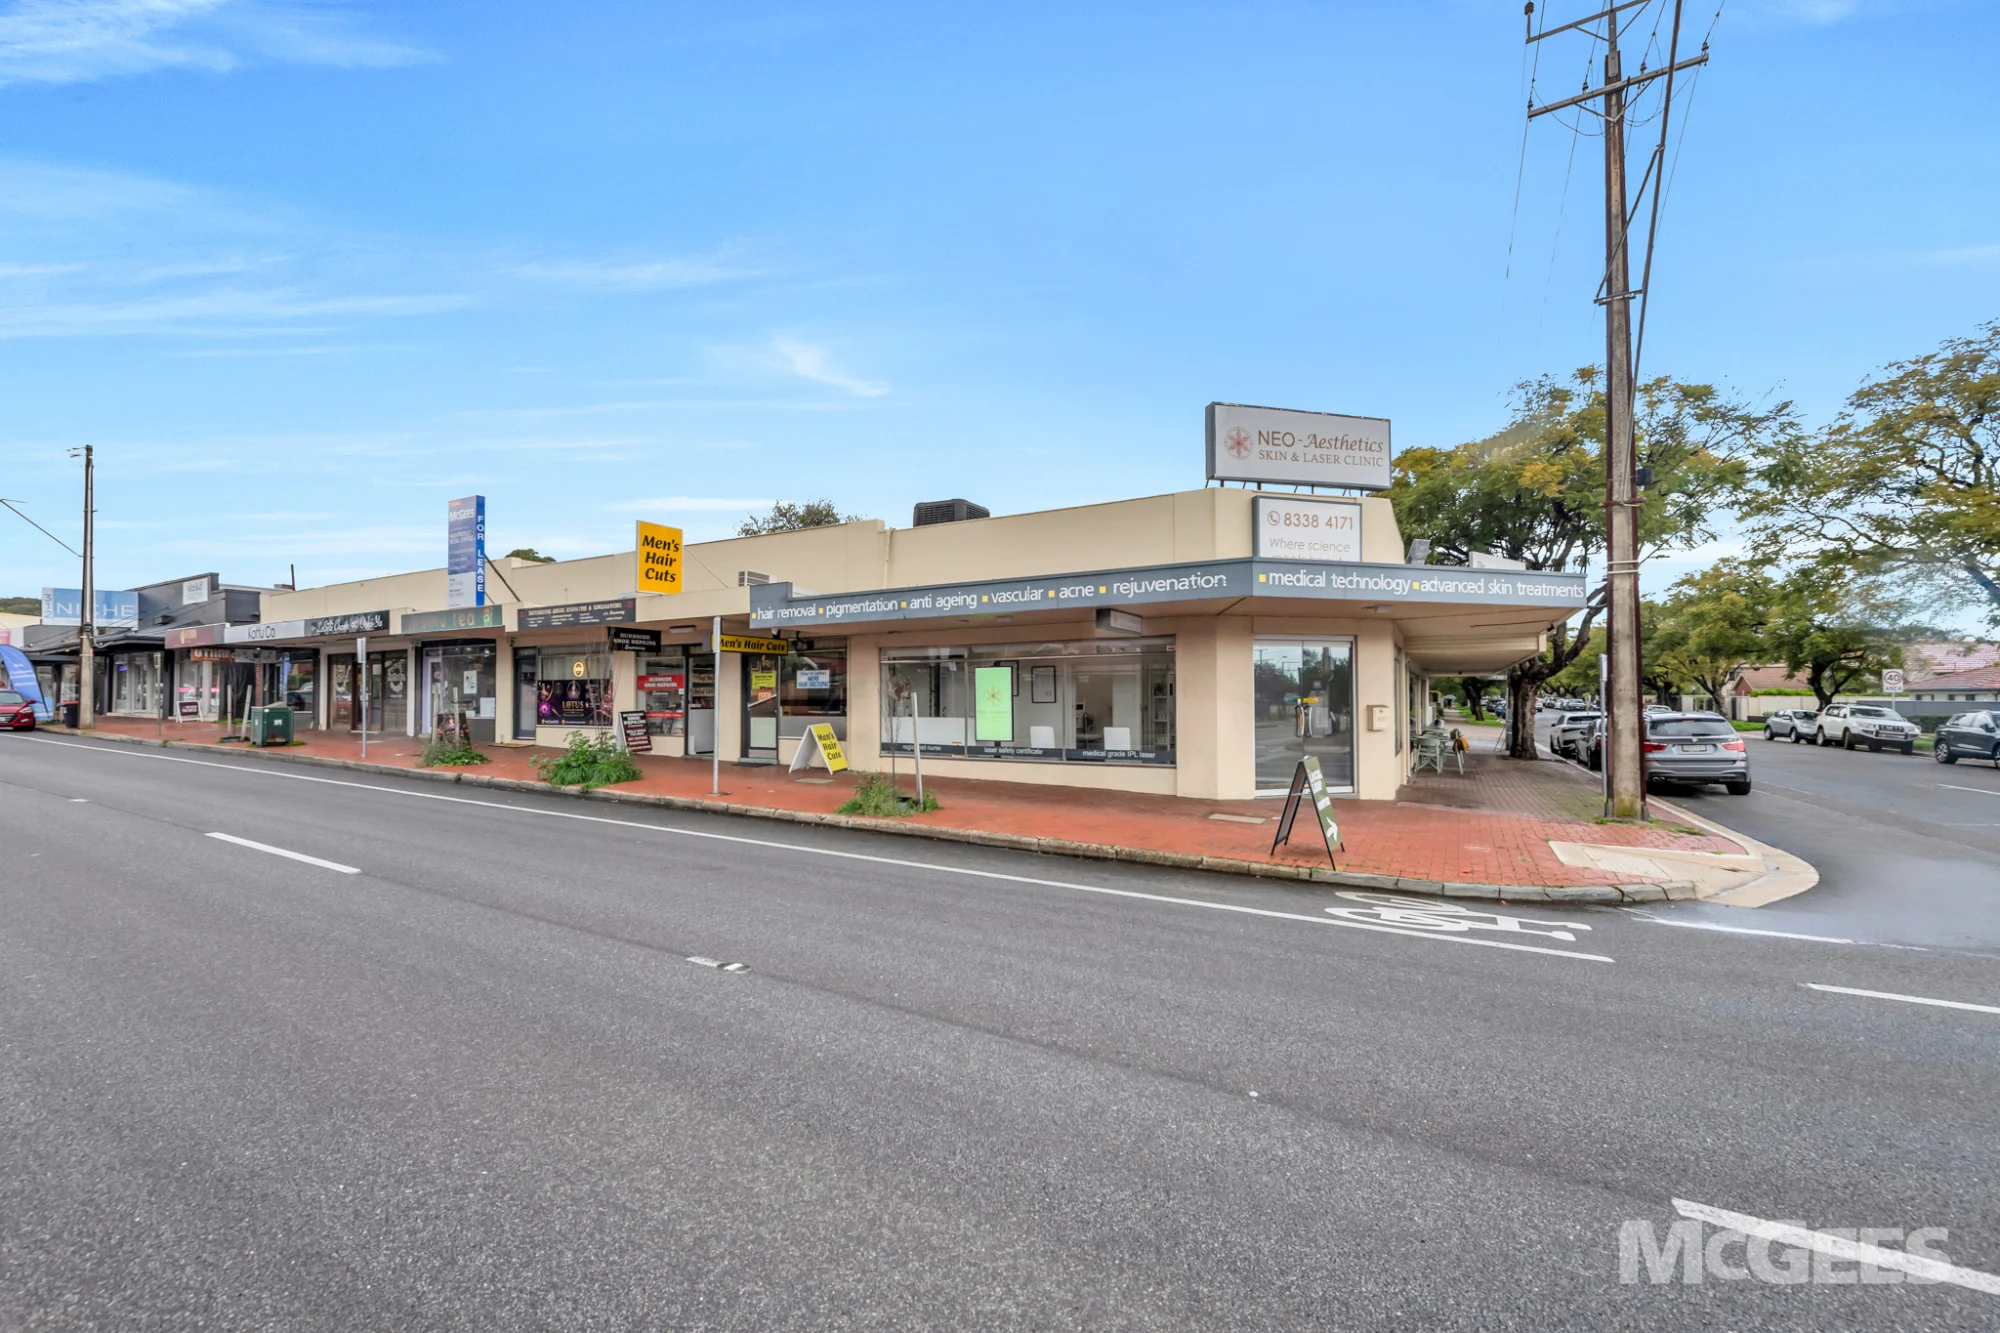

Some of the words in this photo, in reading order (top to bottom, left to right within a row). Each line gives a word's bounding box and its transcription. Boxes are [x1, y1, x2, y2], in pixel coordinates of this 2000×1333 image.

[1259, 450, 1287, 461] SKIN
[1291, 452, 1300, 462] &
[1303, 452, 1341, 465] LASER
[1344, 455, 1384, 467] CLINIC
[477, 515, 485, 541] FOR
[1283, 512, 1319, 529] 8338
[1325, 515, 1353, 531] 4171
[642, 535, 680, 552] Men's
[1269, 537, 1305, 550] Where
[1308, 541, 1351, 553] science
[645, 551, 677, 567] Hair
[477, 549, 485, 593] LEASE
[645, 567, 677, 583] Cuts
[1269, 569, 1326, 588] medical
[1331, 572, 1411, 595] technology
[1420, 576, 1485, 594] advanced
[1488, 579, 1513, 595] skin
[1516, 581, 1584, 598] treatments
[757, 606, 775, 620] hair
[777, 603, 816, 618] removal
[826, 598, 898, 618] pigmentation
[910, 593, 932, 609] anti
[935, 592, 977, 610] ageing
[991, 586, 1044, 603] vascular
[1059, 585, 1095, 598] acne
[1113, 572, 1227, 598] rejuvenation
[744, 640, 764, 650] Hair
[766, 642, 785, 651] Cuts
[1887, 674, 1900, 682] 40
[562, 700, 584, 709] LOTUS
[817, 732, 835, 741] Men's
[822, 741, 837, 750] Hair
[827, 752, 842, 760] Cuts
[1107, 750, 1126, 759] grade
